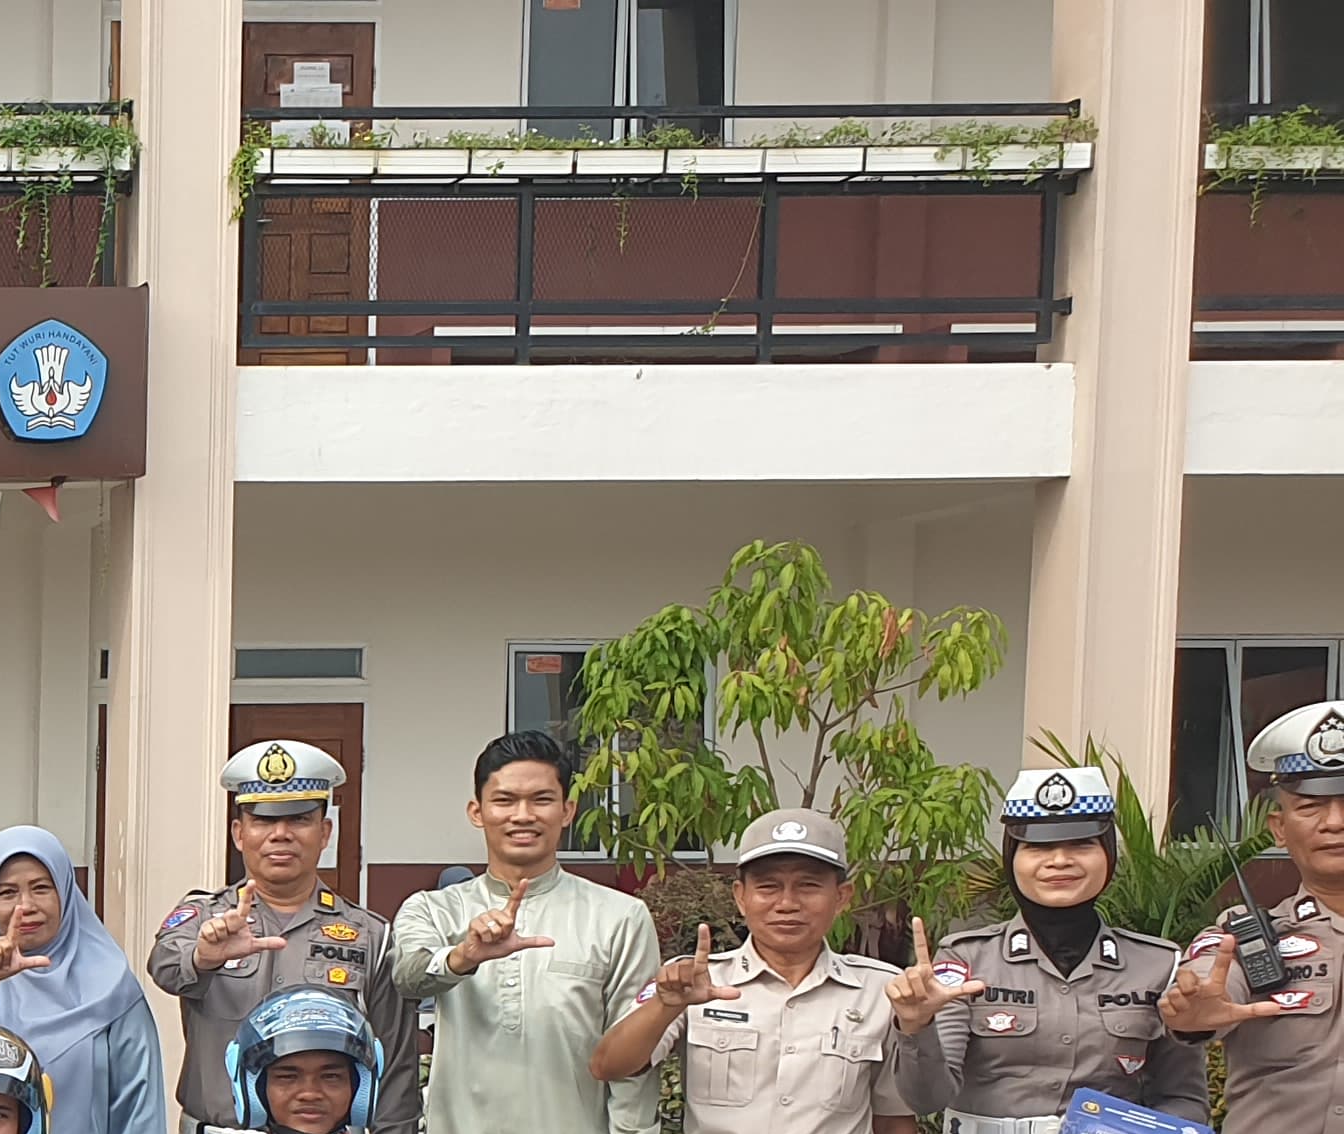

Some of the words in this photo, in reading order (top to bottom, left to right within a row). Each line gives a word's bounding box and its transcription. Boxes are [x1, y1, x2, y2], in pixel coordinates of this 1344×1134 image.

[4, 348, 19, 366] TUT
[19, 331, 46, 350] WURI
[48, 329, 99, 367] HANDAYANI
[310, 943, 365, 964] POLRI
[1097, 991, 1163, 1007] POLR
